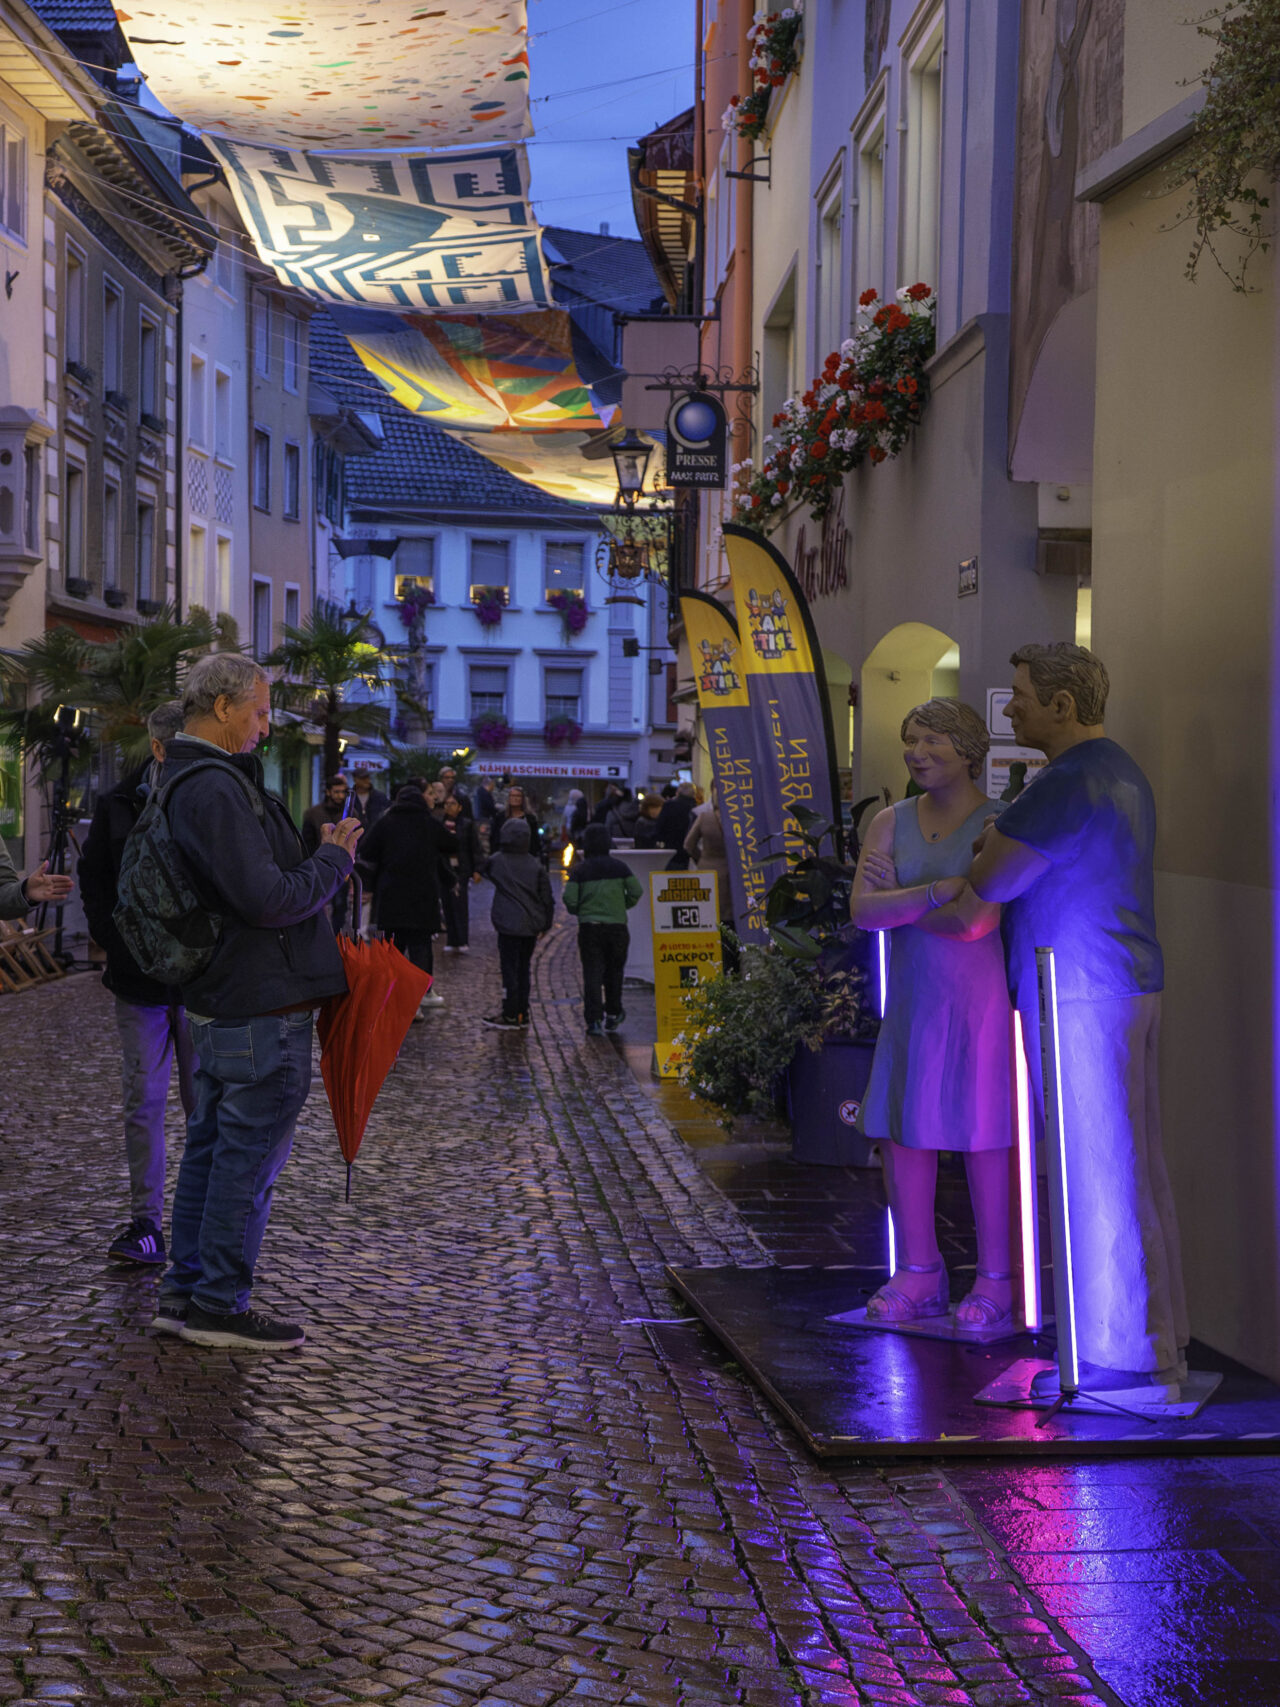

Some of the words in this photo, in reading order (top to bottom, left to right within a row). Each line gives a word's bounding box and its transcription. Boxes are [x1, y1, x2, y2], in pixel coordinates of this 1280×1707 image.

[676, 454, 718, 466] PRESSE
[479, 764, 568, 775] NÄHMASCHINEN
[572, 767, 601, 776] ERNE
[667, 877, 700, 890] EURO
[657, 889, 712, 902] JACKPOT
[677, 908, 700, 926] 120
[660, 952, 715, 963] JACKPOT
